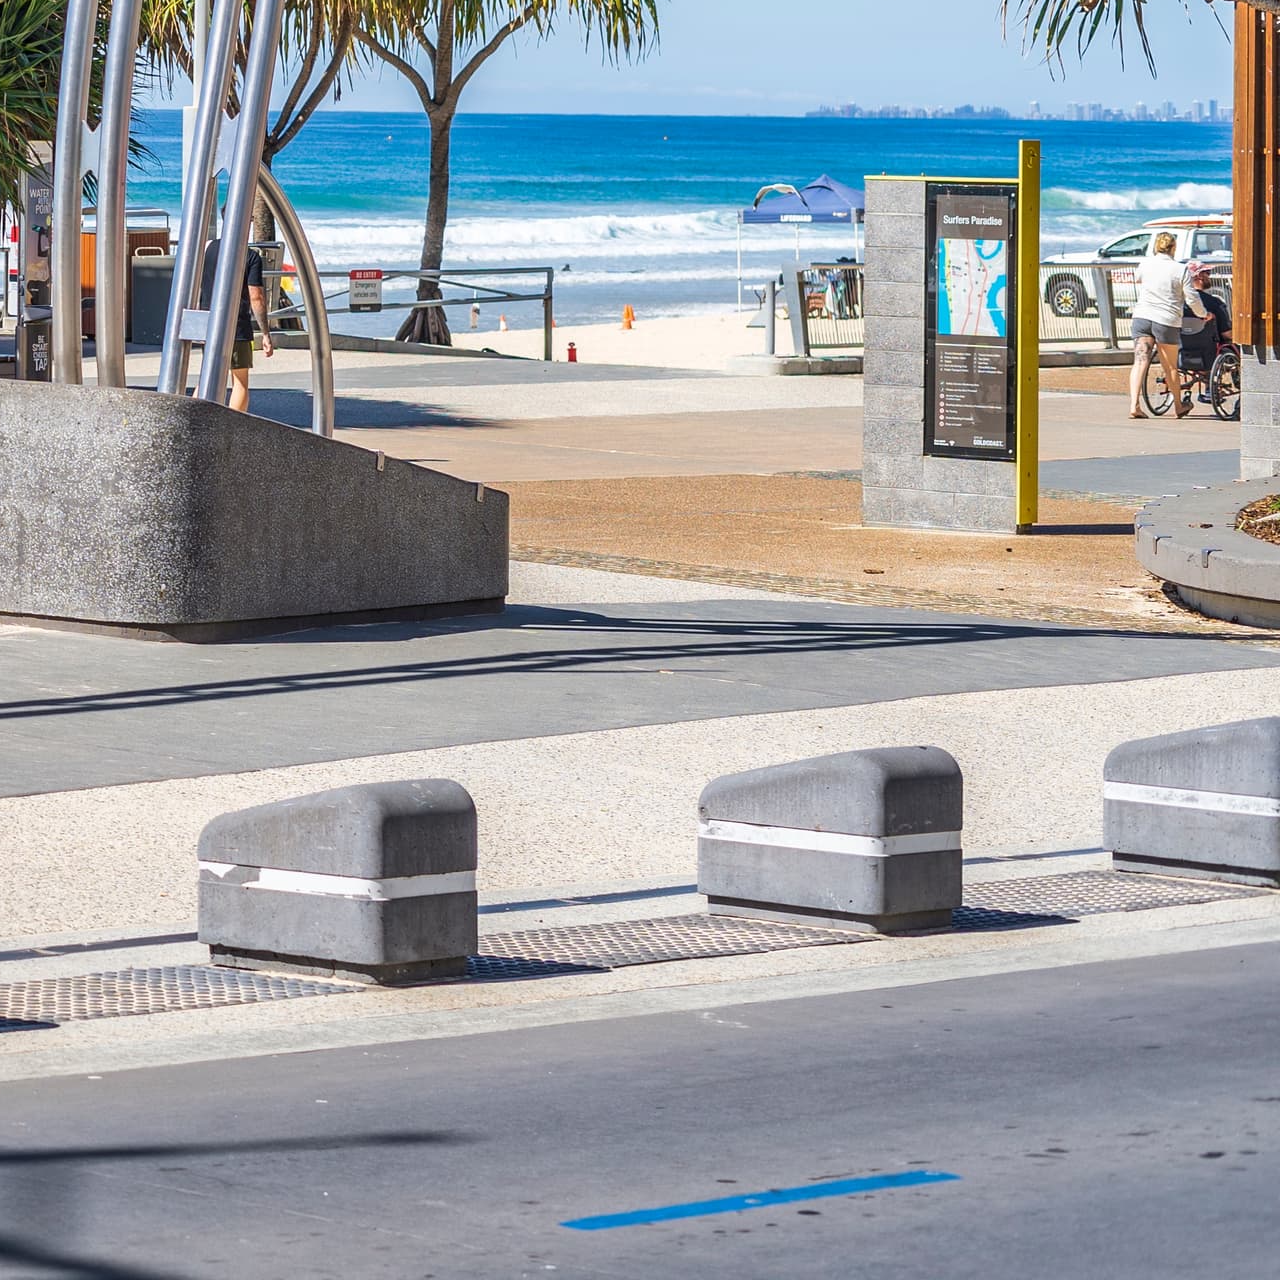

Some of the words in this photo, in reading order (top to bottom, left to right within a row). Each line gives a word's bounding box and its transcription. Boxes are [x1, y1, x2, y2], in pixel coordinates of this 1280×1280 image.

[943, 214, 970, 225] Surfers
[970, 215, 1003, 226] Paradise
[33, 358, 48, 372] TAP
